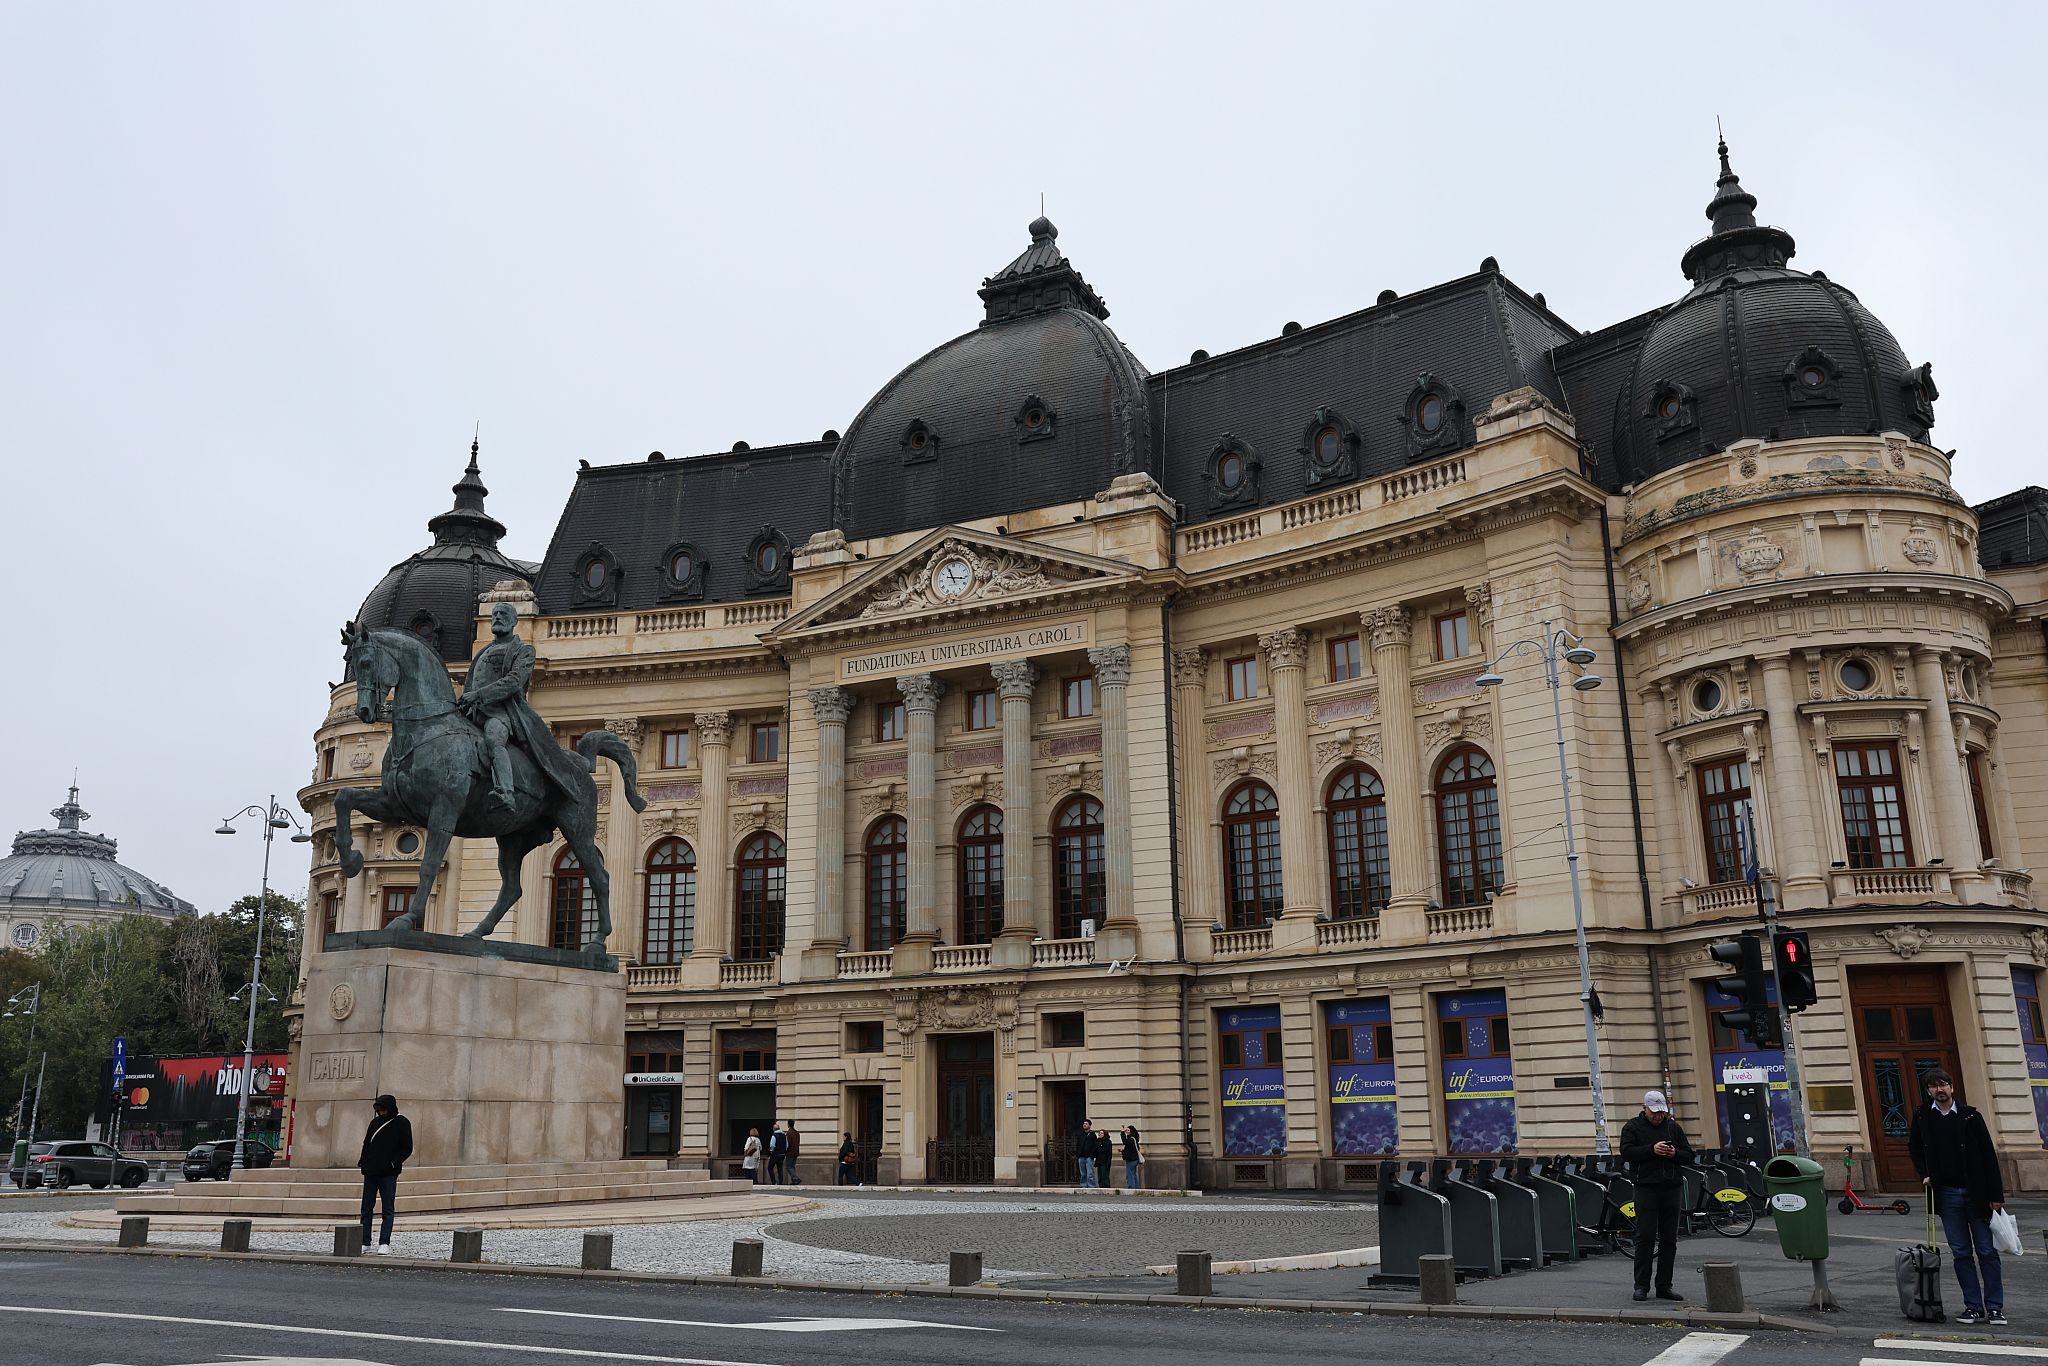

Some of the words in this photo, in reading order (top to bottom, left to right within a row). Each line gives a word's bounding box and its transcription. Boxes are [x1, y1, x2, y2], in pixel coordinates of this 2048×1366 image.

[847, 650, 926, 674] FUNDATIUNEA
[931, 634, 1022, 661] UNIVERSITARA
[1028, 627, 1072, 647] CAROL
[1077, 625, 1082, 639] I
[313, 1055, 355, 1080] CAROL
[1480, 1075, 1513, 1083] EUROPA
[1254, 1083, 1284, 1092] EUROPA
[1364, 1080, 1396, 1088] EUROPA
